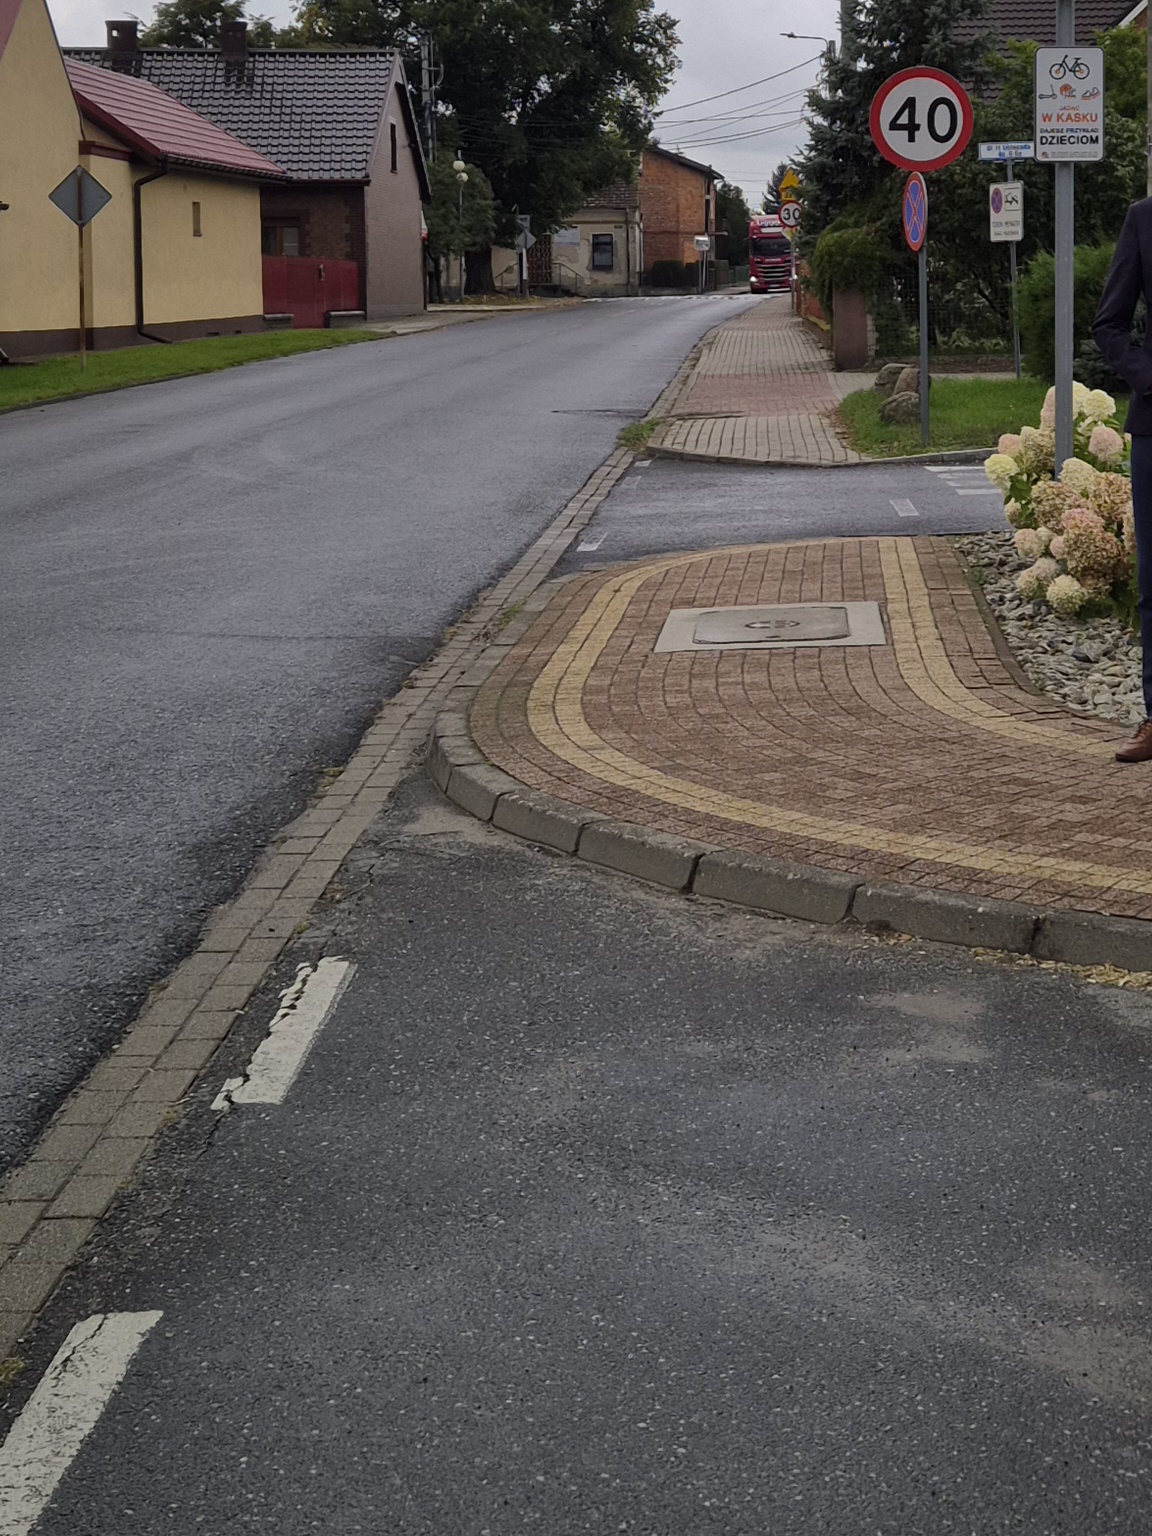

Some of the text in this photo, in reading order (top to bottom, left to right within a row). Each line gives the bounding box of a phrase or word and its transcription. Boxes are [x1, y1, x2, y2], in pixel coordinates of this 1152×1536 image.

[888, 96, 958, 144] 40
[1041, 112, 1098, 123] W KASKU
[1040, 134, 1099, 146] DZIECIOM
[783, 207, 801, 221] 30
